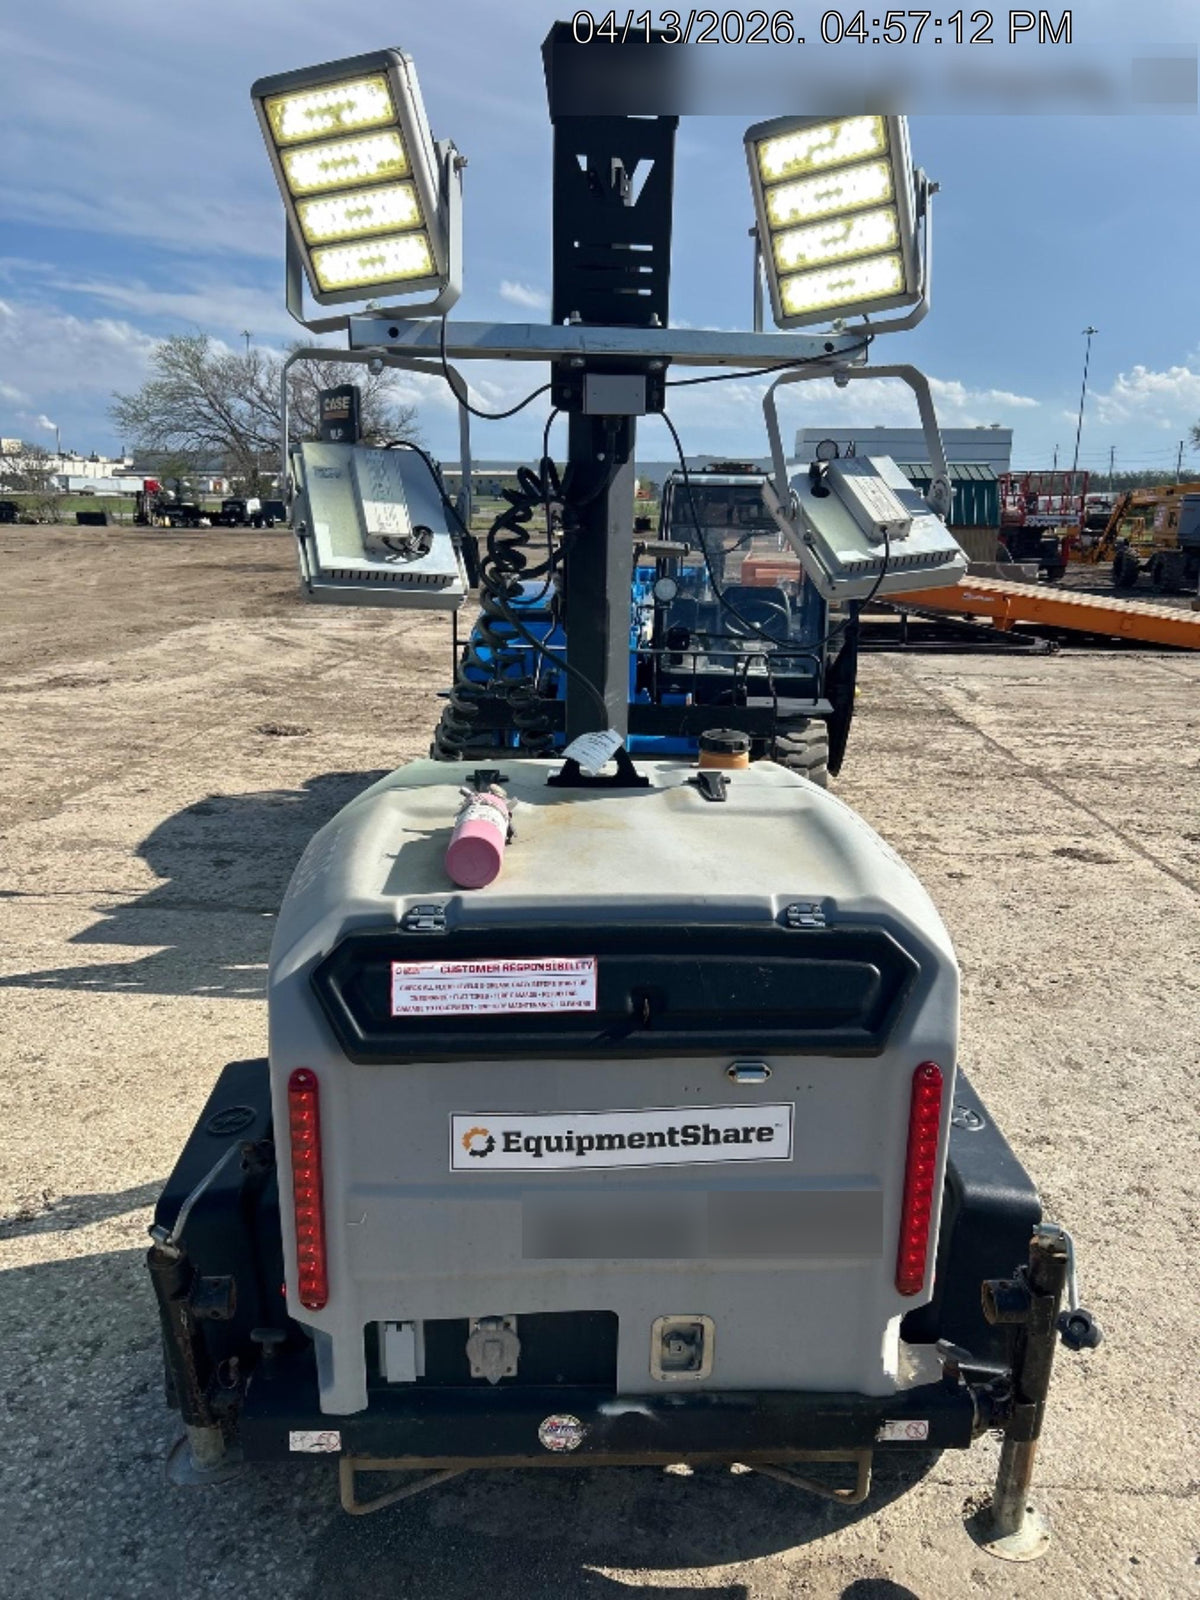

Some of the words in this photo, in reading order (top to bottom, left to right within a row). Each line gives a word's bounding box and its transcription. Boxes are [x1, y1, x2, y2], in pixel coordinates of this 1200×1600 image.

[440, 964, 500, 975] CUSTOMER
[502, 961, 593, 973] RESPONSIBILITY
[502, 1123, 775, 1158] EquipmentShare
